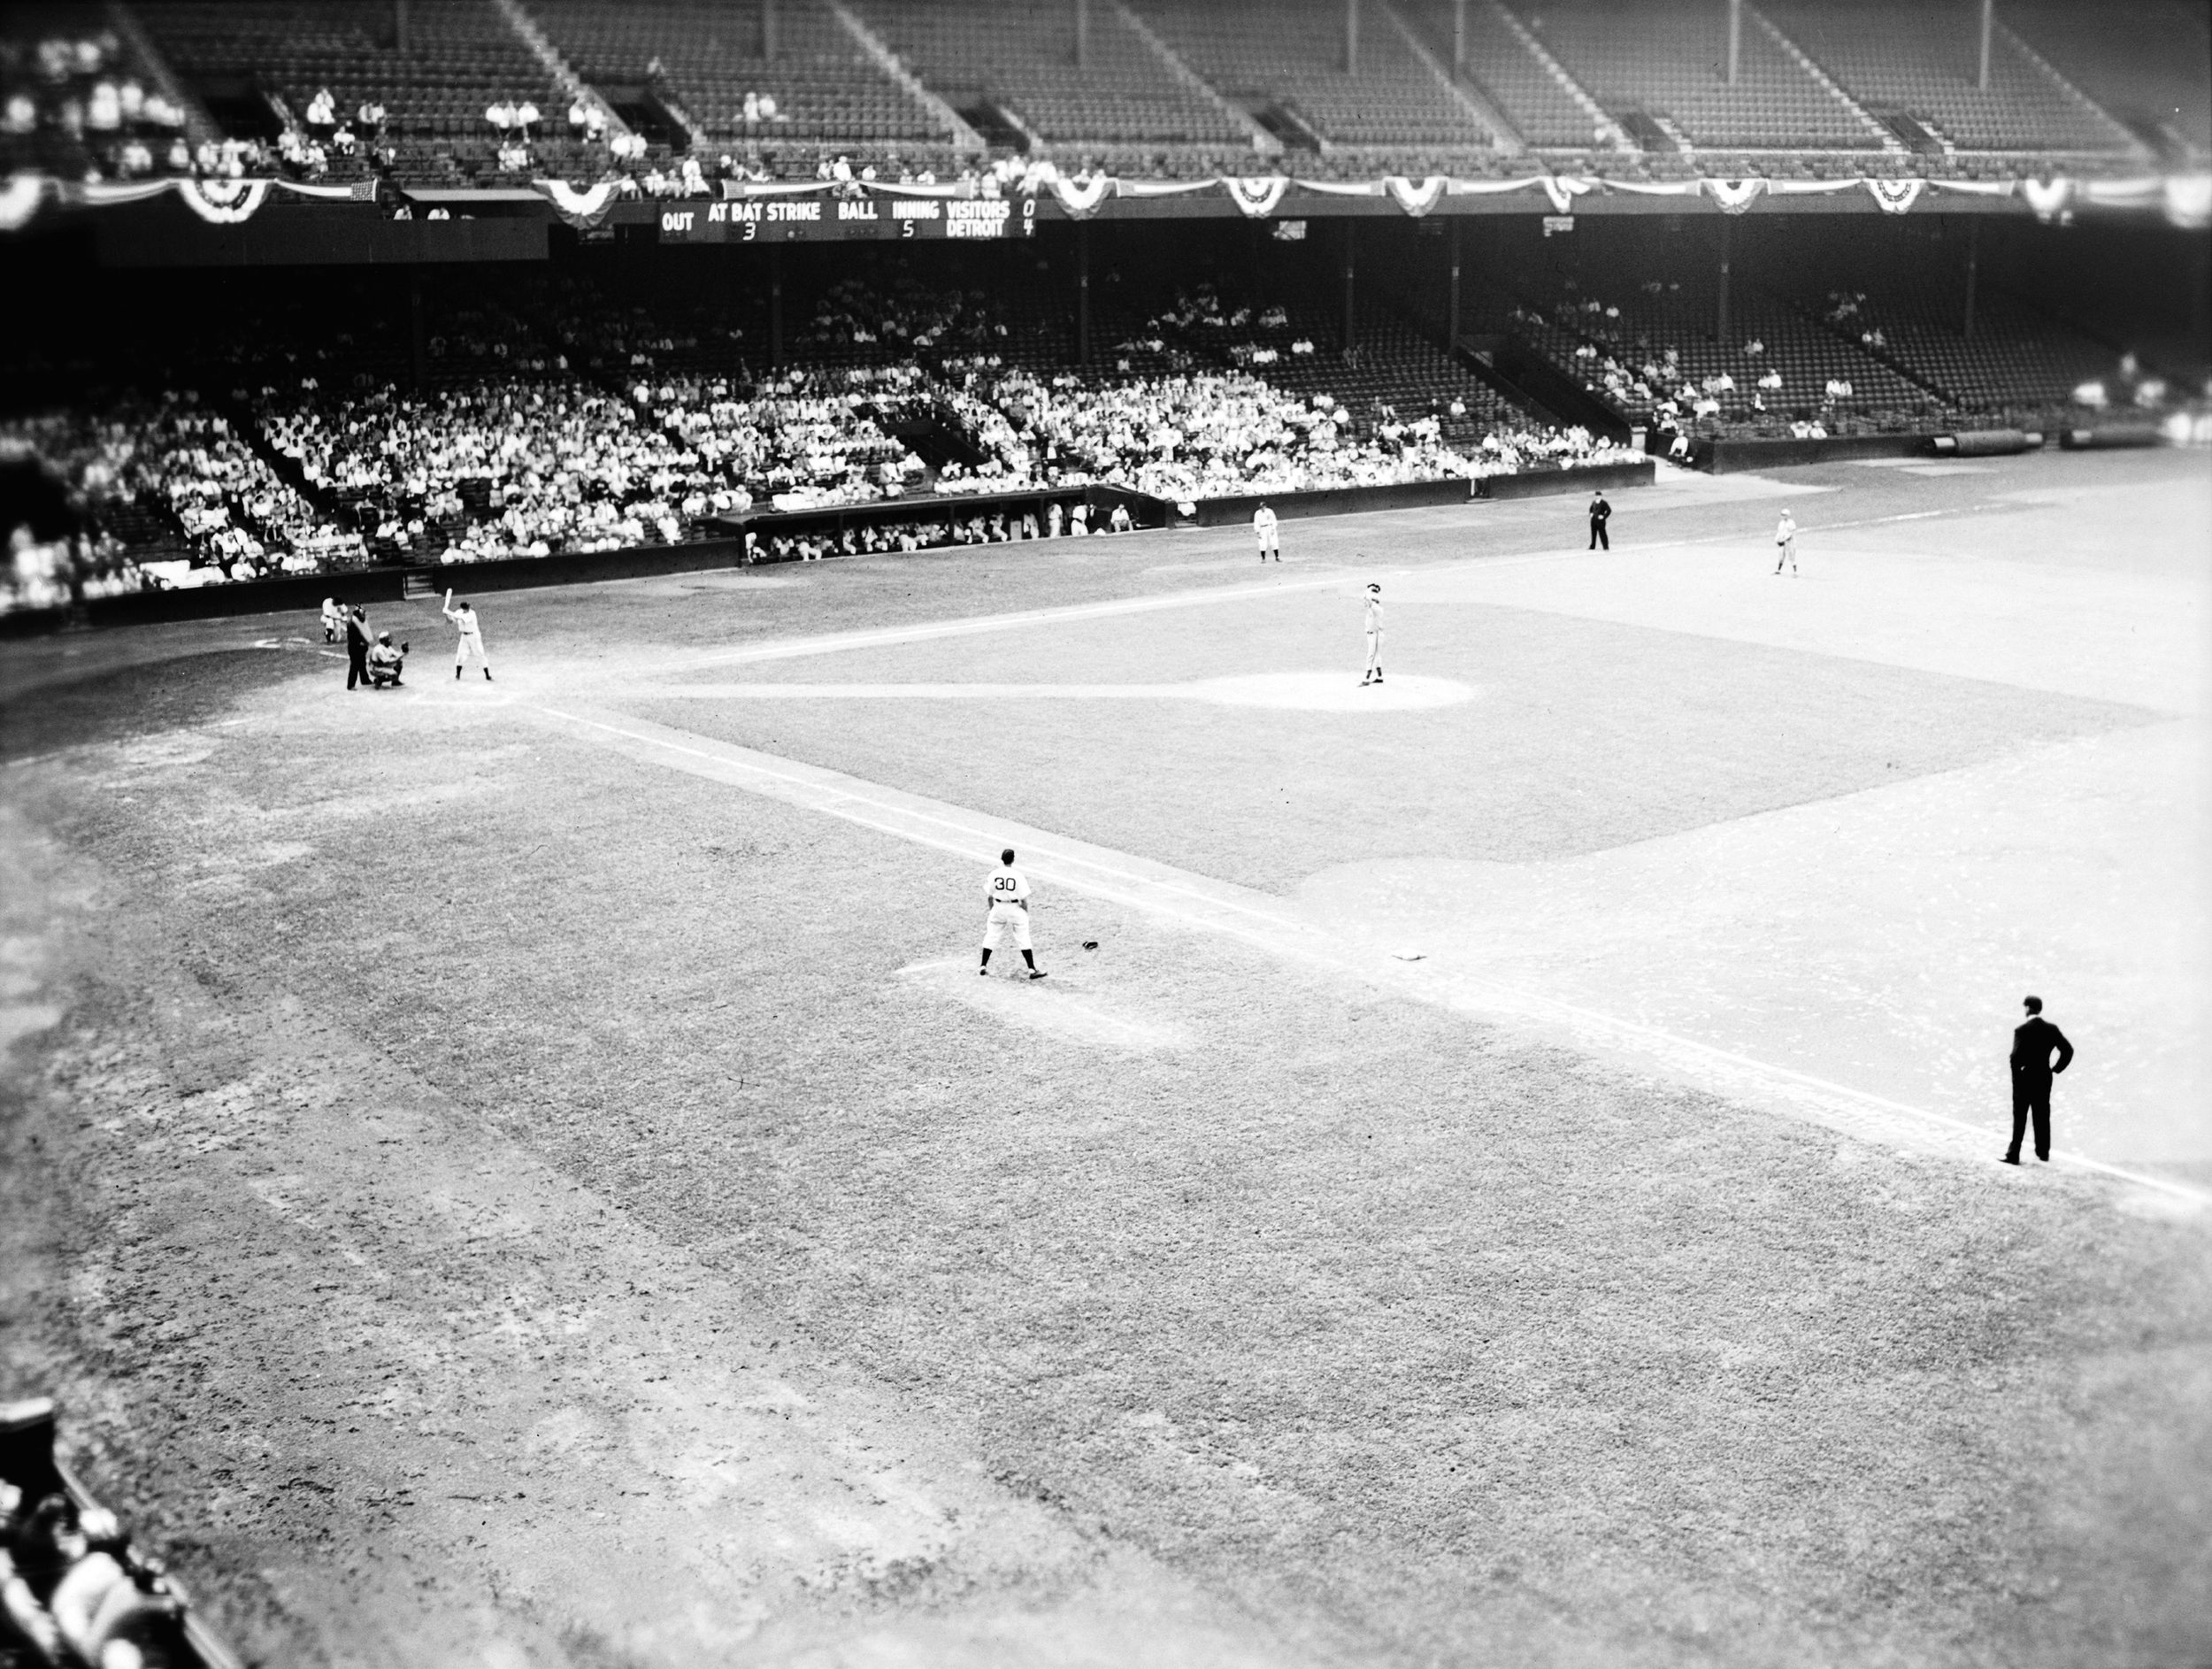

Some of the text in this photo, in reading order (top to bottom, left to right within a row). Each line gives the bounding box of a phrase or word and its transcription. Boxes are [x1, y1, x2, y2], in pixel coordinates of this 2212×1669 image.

[708, 203, 763, 222] AT BAT
[766, 202, 821, 221] STRIKE
[838, 201, 879, 220] BALL
[892, 200, 940, 219] INNING
[946, 198, 1036, 219] VISITORS 0
[662, 212, 695, 231] OUT
[742, 221, 757, 241] 3
[902, 219, 915, 237] 5
[946, 218, 1034, 237] DETROIT 4
[994, 877, 1017, 891] 30
